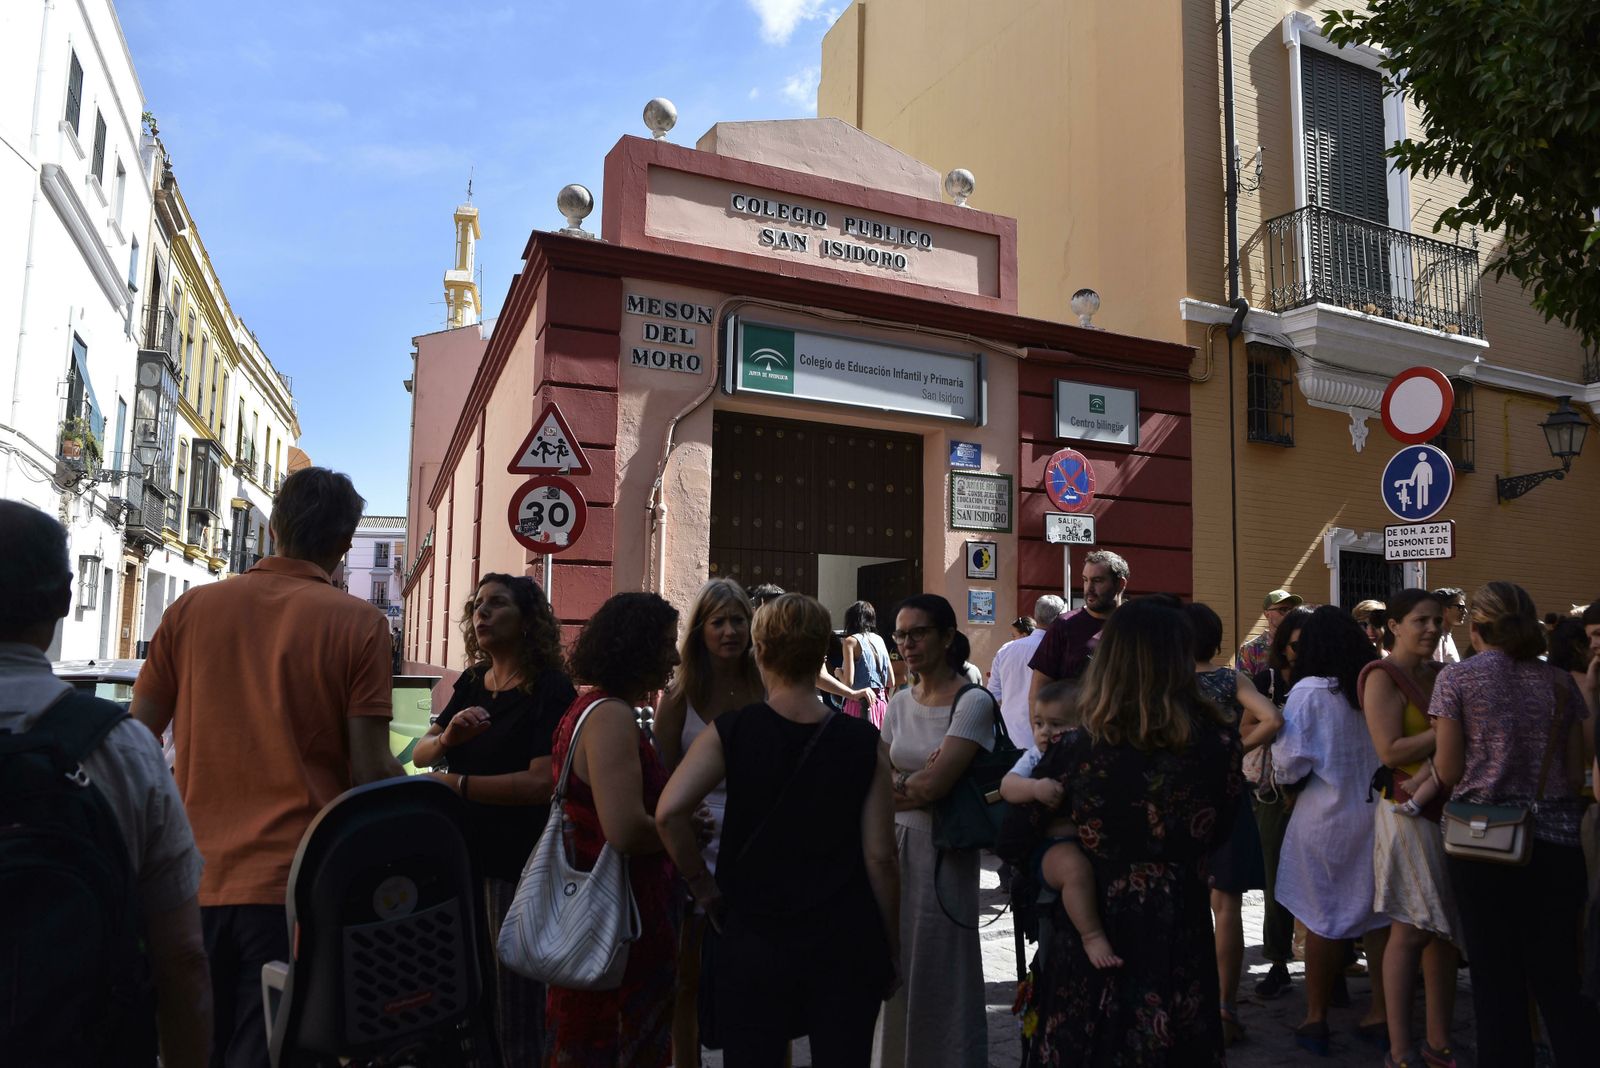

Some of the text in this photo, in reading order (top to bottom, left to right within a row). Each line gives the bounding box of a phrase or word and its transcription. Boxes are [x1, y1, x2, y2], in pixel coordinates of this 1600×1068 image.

[732, 194, 932, 248] COLEGIO PUBLICO
[761, 229, 907, 270] SAN ISIDORO
[627, 295, 713, 324] MESON
[644, 323, 694, 345] DEL
[632, 348, 701, 371] MORO
[800, 353, 964, 388] Colegio de Educación Infantil y Primaria
[922, 388, 964, 405] San Isidoro
[1070, 416, 1125, 433] Centro bilingüe
[526, 501, 569, 527] 30
[956, 510, 1007, 524] SAN ISIDORO
[1429, 526, 1440, 534] 22
[1441, 525, 1449, 533] H.
[1388, 536, 1448, 547] DESMONTE DE
[1390, 548, 1446, 558] LA BICICLETA
